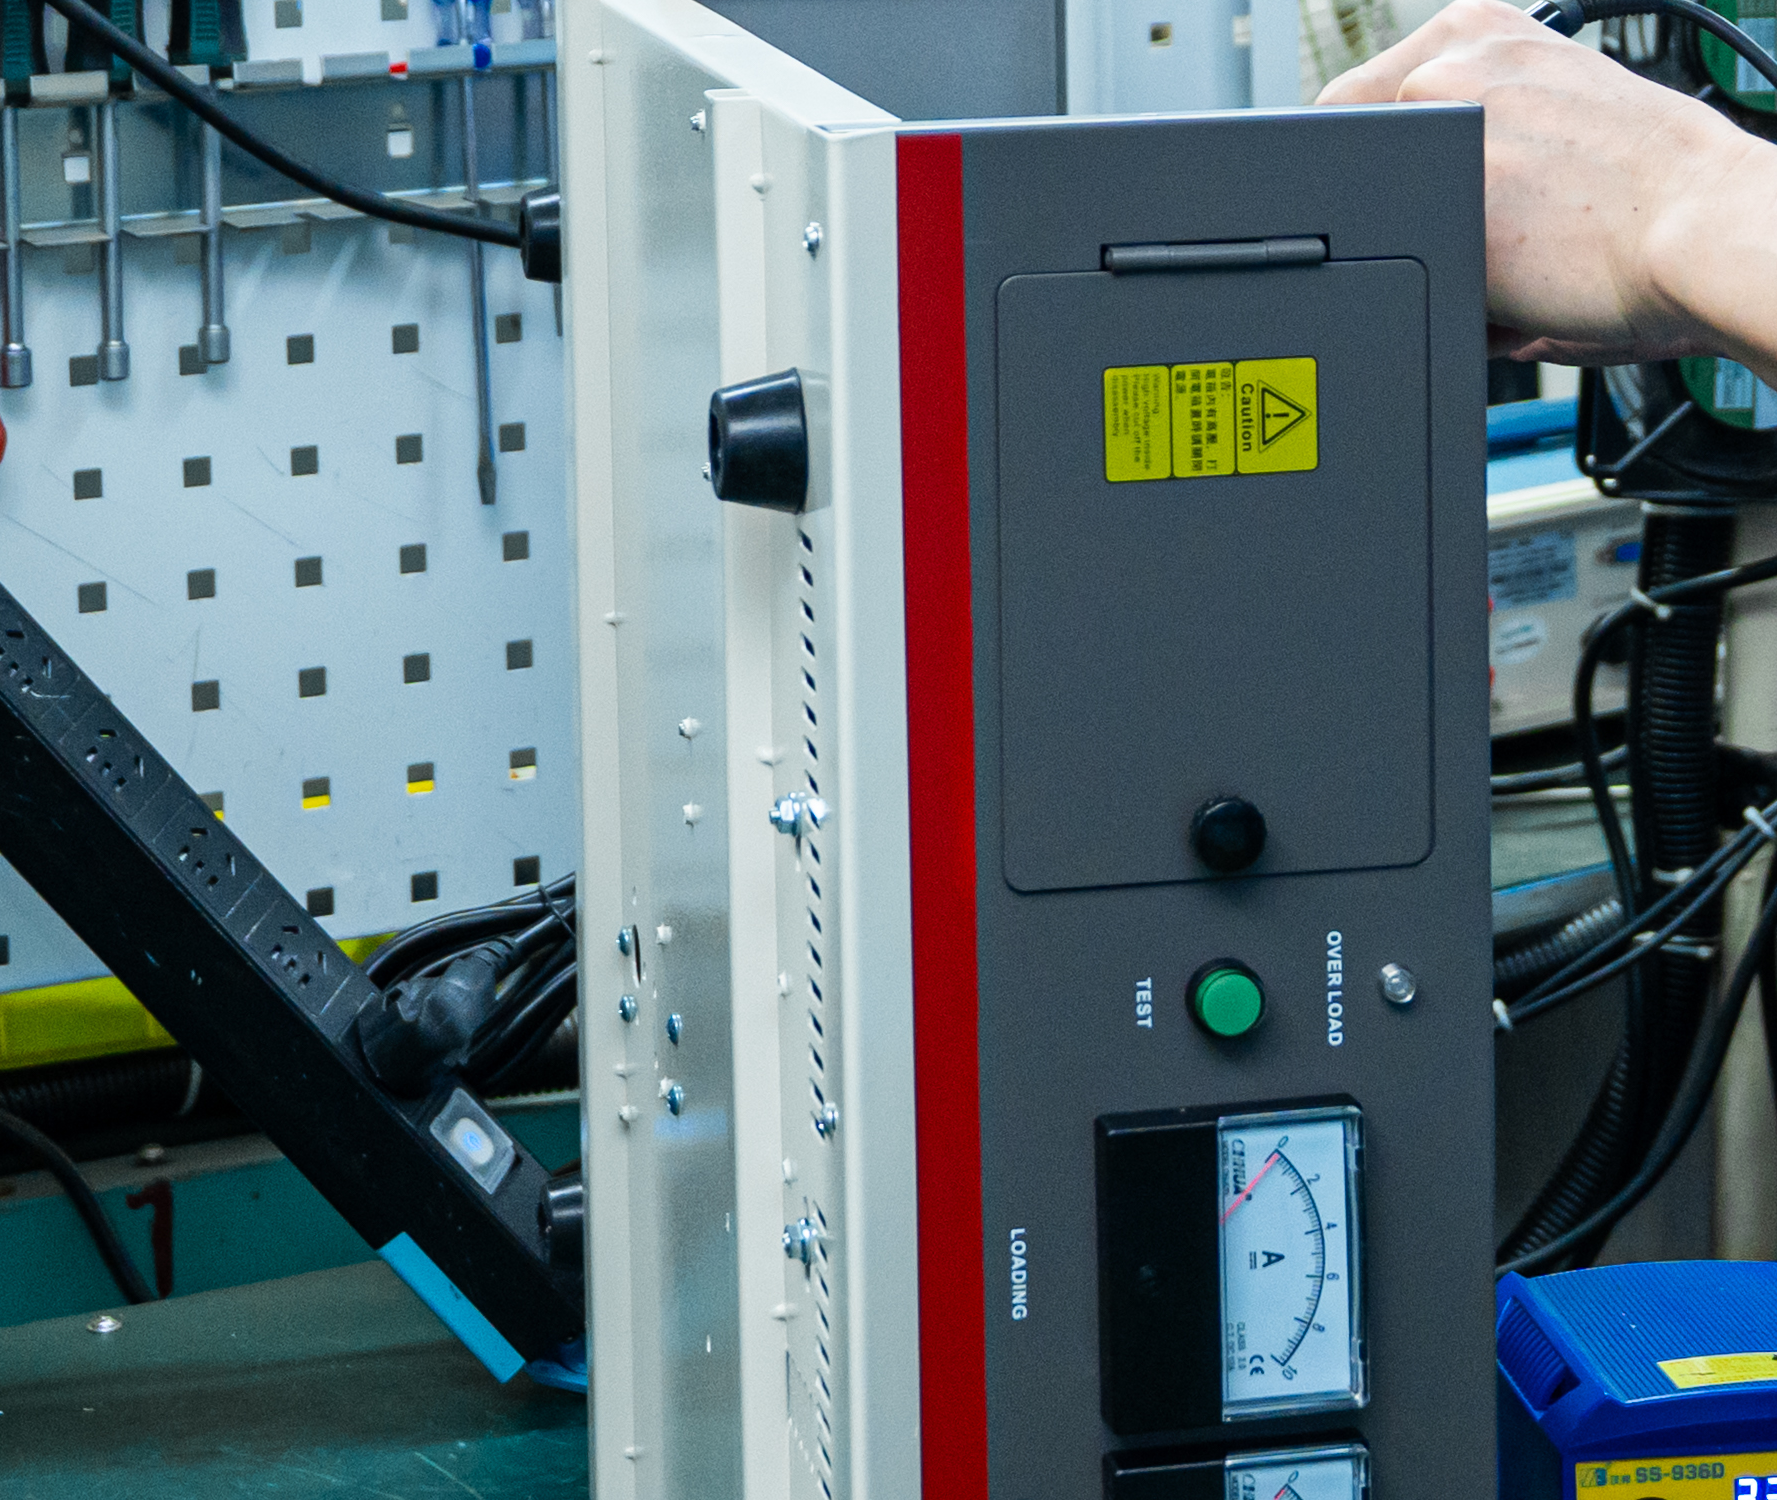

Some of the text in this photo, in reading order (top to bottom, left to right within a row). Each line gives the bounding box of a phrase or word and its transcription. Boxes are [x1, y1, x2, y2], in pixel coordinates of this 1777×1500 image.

[1241, 383, 1255, 452] Caution
[1326, 930, 1344, 1047] OVER LOAD
[1135, 977, 1152, 1028] TEST
[1277, 1135, 1289, 1148] 0
[1307, 1173, 1320, 1185] 2
[1326, 1221, 1338, 1231] 4
[1261, 1250, 1286, 1268] A
[1010, 1228, 1027, 1320] LOADING
[1326, 1272, 1339, 1281] 6
[1312, 1323, 1325, 1333] 8
[1282, 1367, 1298, 1381] 10
[1635, 1462, 1725, 1483] SS-936D
